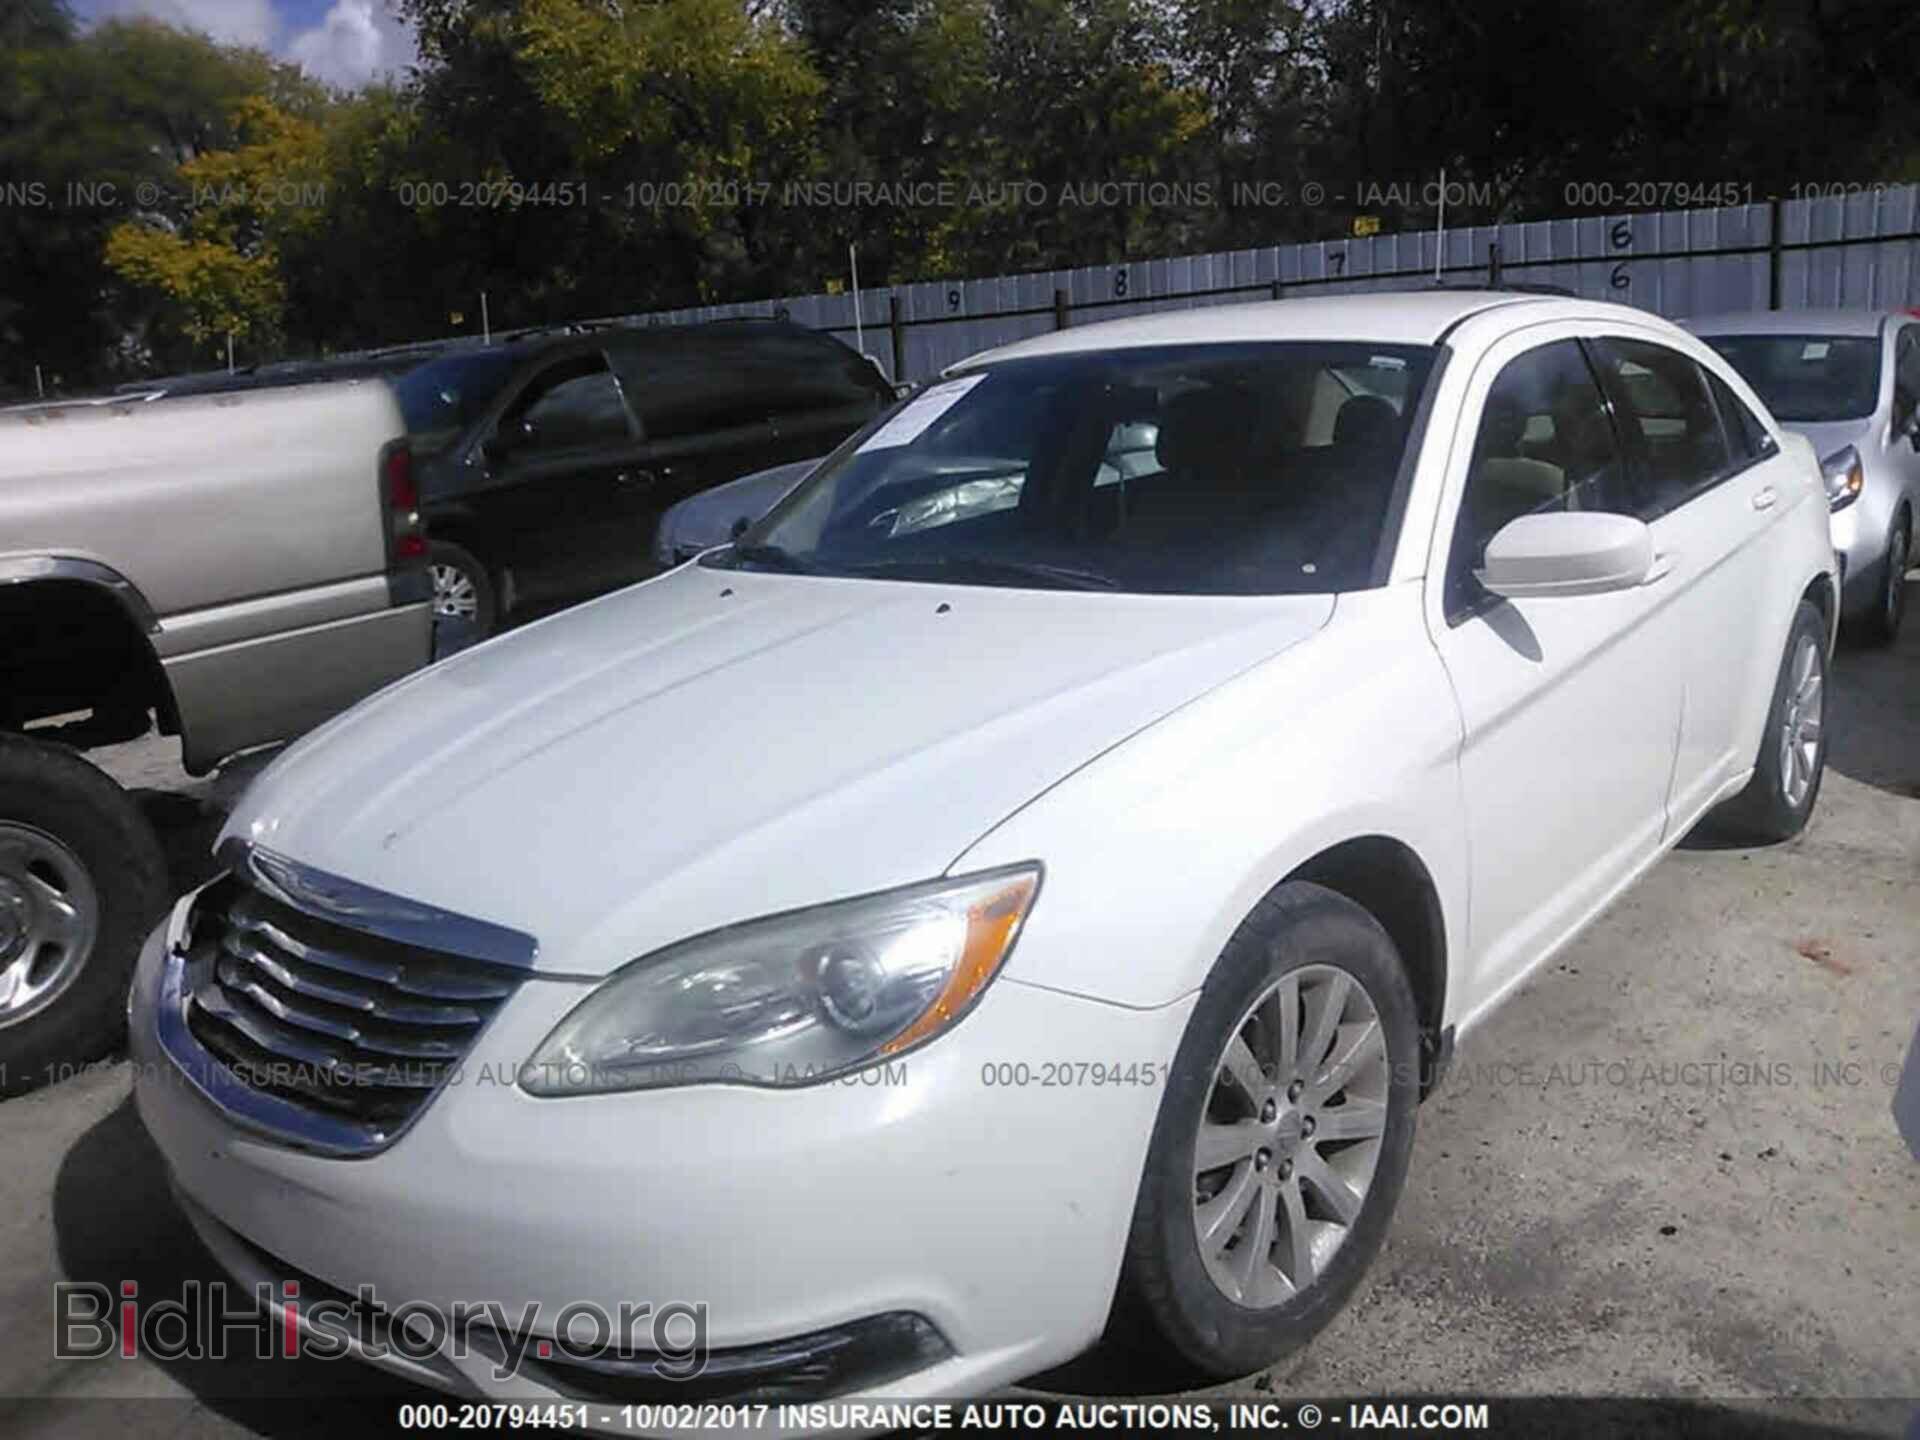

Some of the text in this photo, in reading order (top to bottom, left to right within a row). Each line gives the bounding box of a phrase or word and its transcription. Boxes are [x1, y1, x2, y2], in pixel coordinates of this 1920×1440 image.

[1611, 221, 1632, 249] 6
[1328, 253, 1345, 275] 7
[1611, 262, 1630, 288] 6
[1115, 270, 1126, 296] 8
[949, 289, 961, 312] 9
